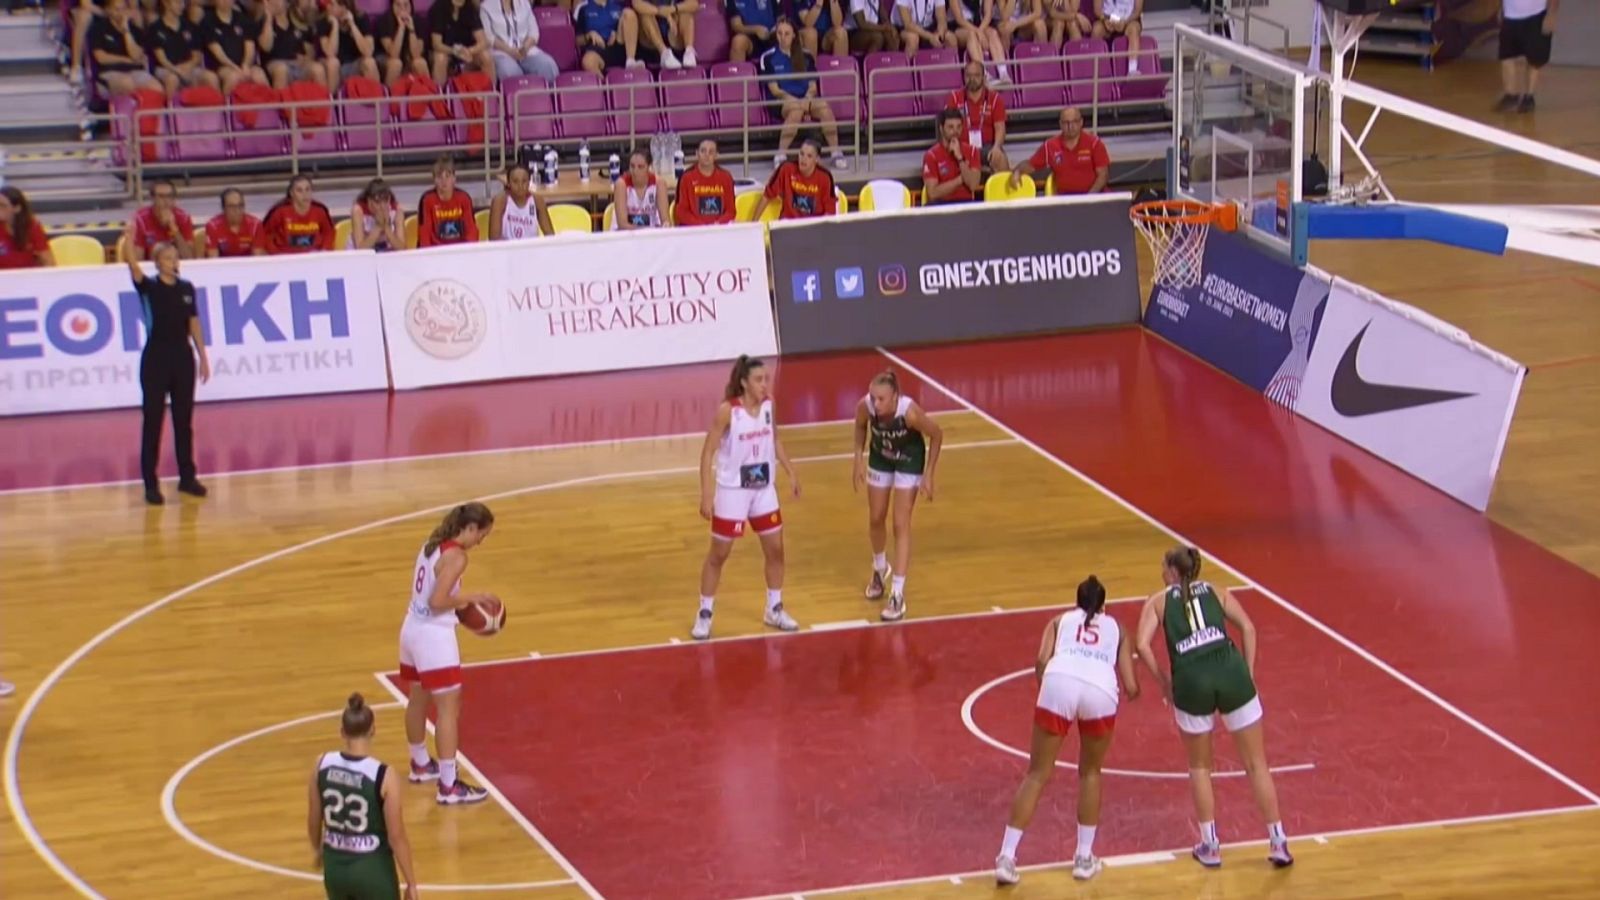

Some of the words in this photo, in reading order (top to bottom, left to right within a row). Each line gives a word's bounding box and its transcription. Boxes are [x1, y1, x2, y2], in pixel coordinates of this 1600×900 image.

[506, 272, 711, 312] MUNICIPALITY
[716, 268, 752, 295] OF
[919, 248, 1121, 295] @NEXTGENHOOPS
[548, 297, 717, 336] HERAKLION
[213, 348, 354, 378] ΑΛΙΣΤΙΚΗ
[415, 565, 426, 595] 8
[1076, 624, 1100, 646] 15
[322, 787, 369, 833] 23
